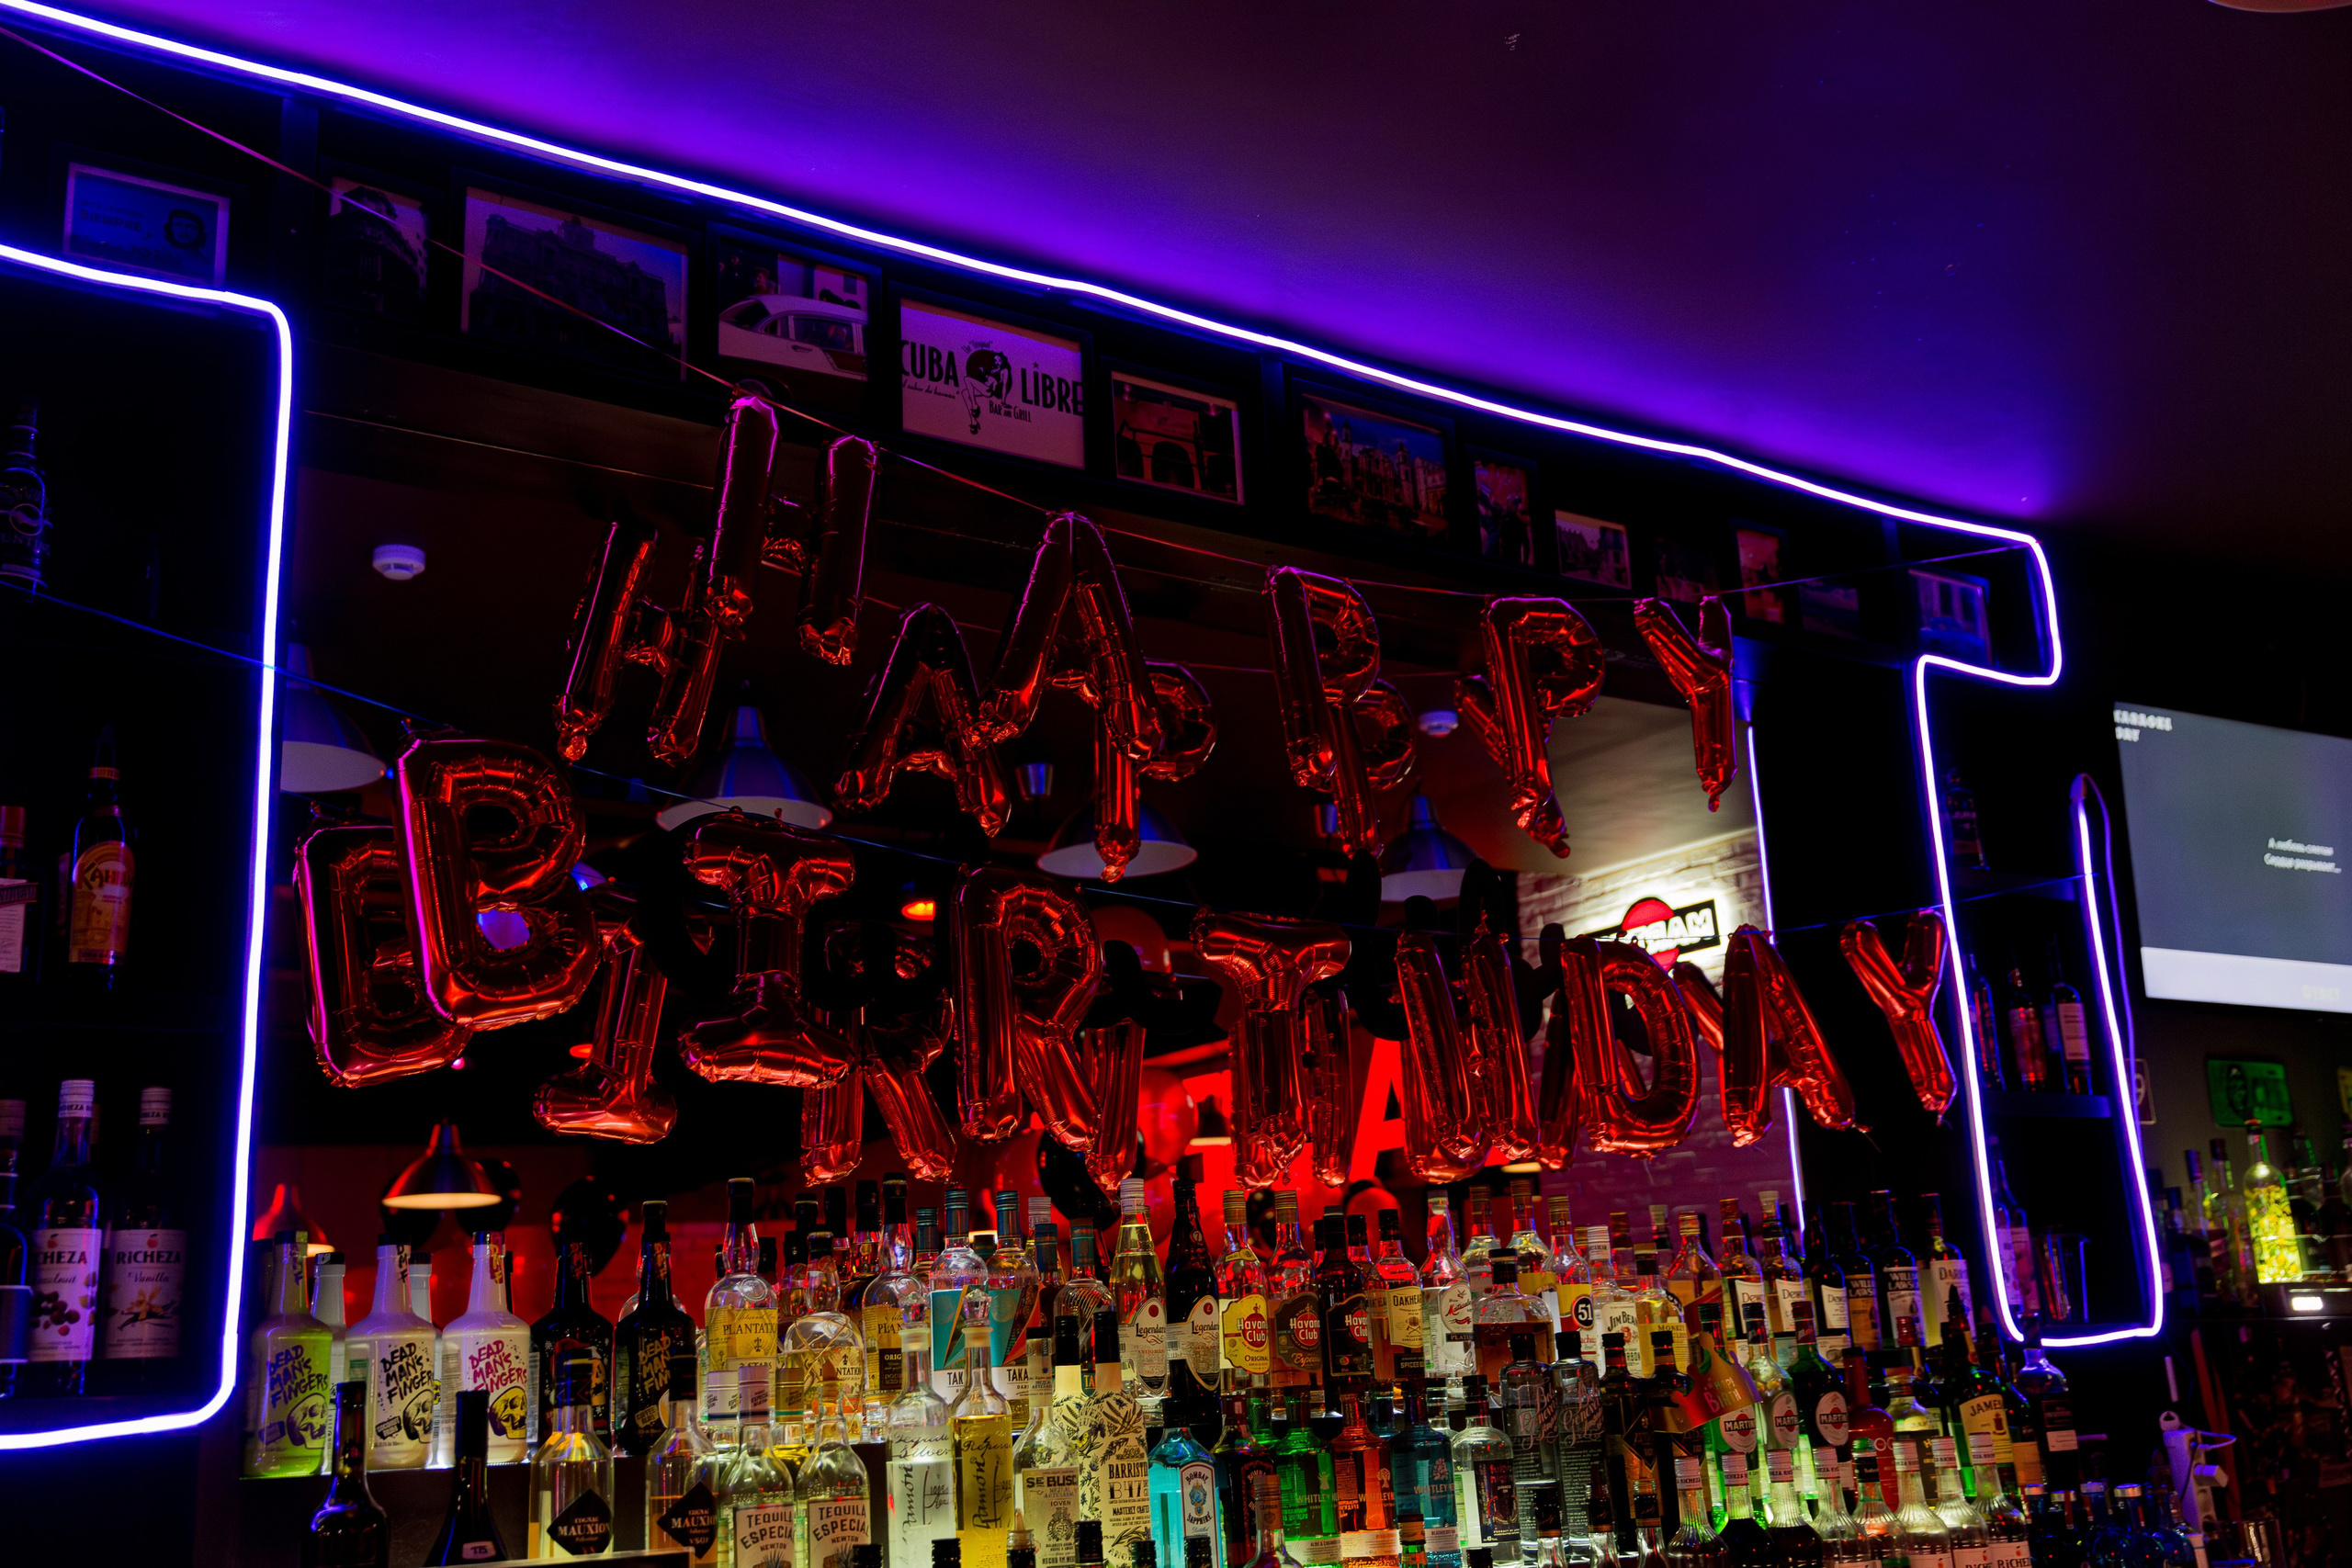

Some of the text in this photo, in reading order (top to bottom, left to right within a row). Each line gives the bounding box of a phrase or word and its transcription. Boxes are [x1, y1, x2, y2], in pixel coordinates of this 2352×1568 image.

[706, 393, 1738, 859] HAPPY
[393, 735, 1963, 1192] BIRTHDAY
[1577, 1303, 1594, 1321] 51
[1608, 1313, 1622, 1331] JIM
[1246, 1330, 1266, 1342] Club
[1298, 1329, 1318, 1341] Club
[267, 1344, 304, 1375] DEAD
[380, 1342, 417, 1373] DEAD
[469, 1339, 504, 1370] DEAD
[638, 1335, 672, 1365] DEAD
[270, 1357, 312, 1392] MAN'S
[386, 1355, 424, 1387] MAN'S
[472, 1352, 513, 1383] MAN'S
[271, 1372, 329, 1408] FINGERS
[1185, 1471, 1210, 1484] BOMBAY
[819, 1505, 866, 1521] TEQUILA
[1186, 1511, 1213, 1525] SAPPHIRE
[812, 1518, 870, 1541] ESPECIAL
[831, 1535, 860, 1544] NEWTON
[760, 1542, 787, 1551] NEWTON
